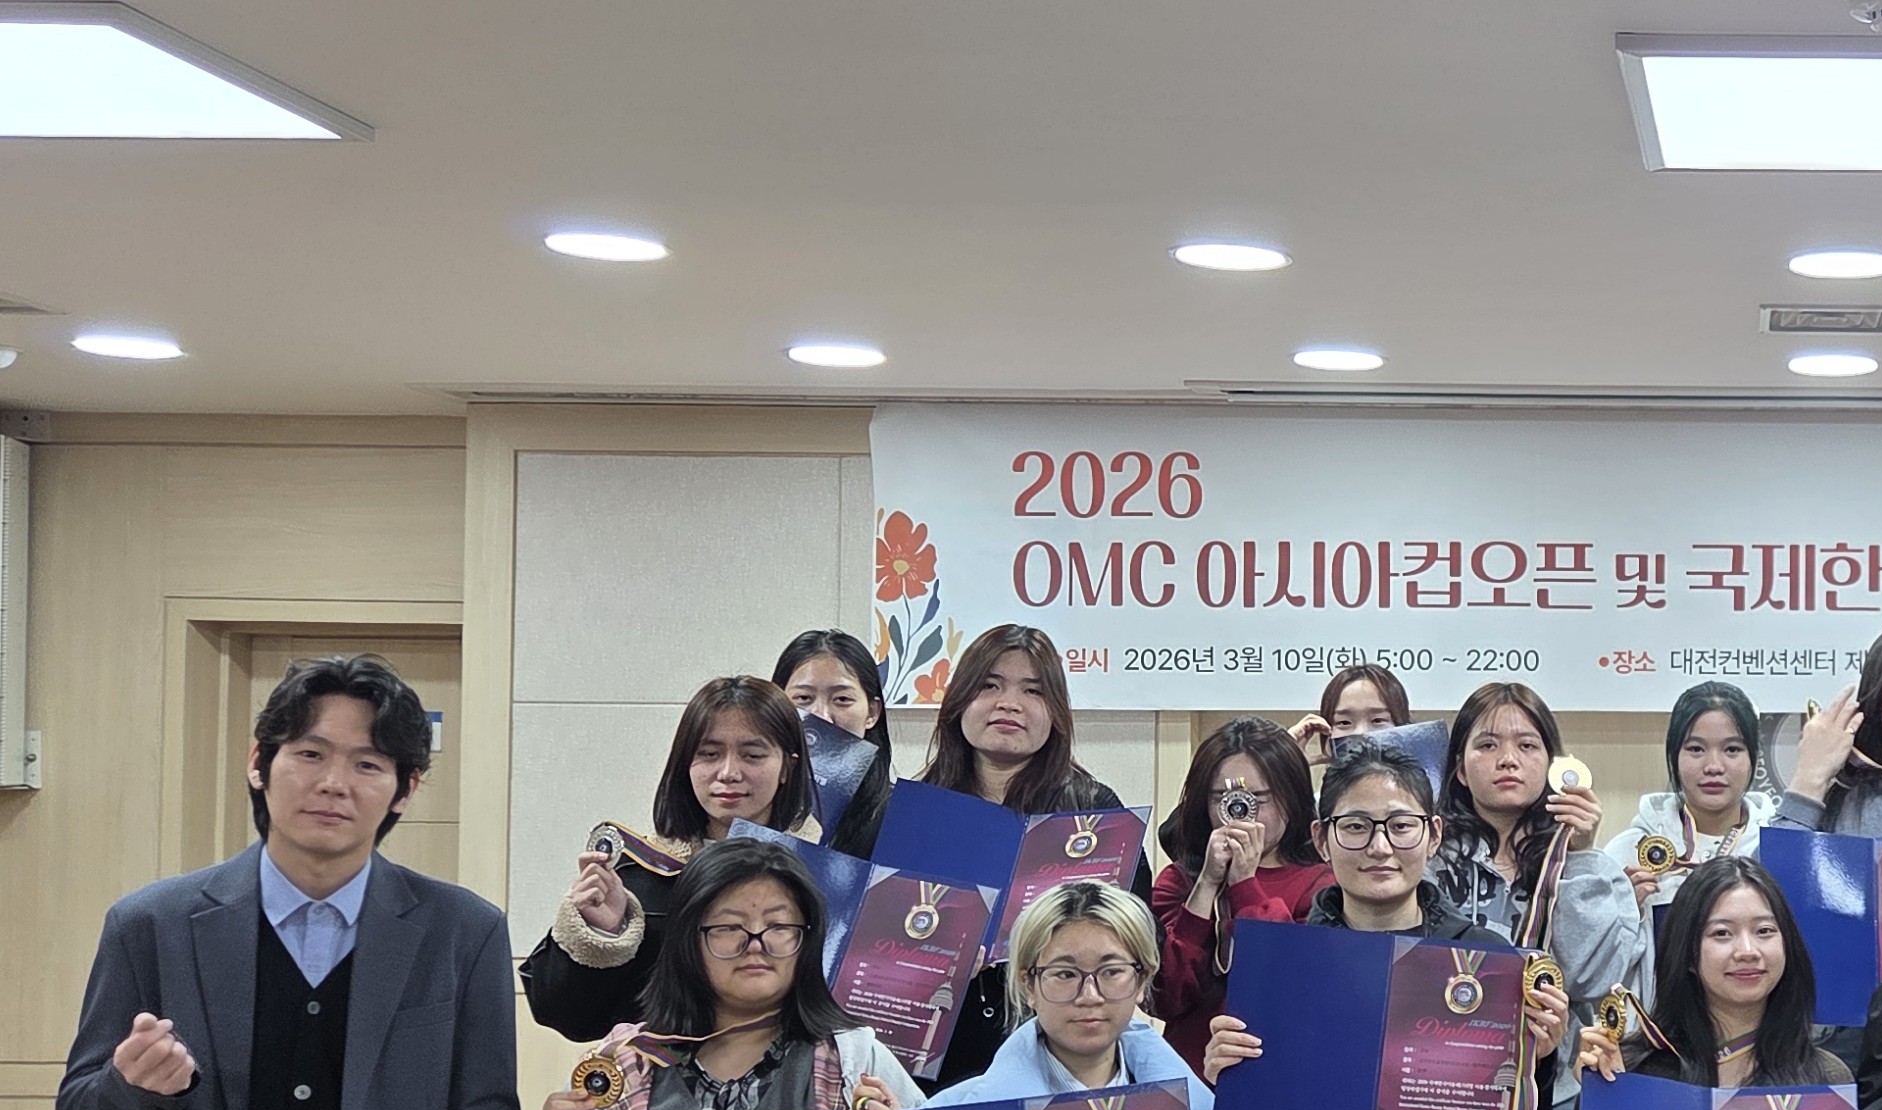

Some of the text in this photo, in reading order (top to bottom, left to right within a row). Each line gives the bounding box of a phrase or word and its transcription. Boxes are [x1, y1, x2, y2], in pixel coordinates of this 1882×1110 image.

[1011, 449, 1204, 519] 2026
[1012, 540, 1177, 609] OMC
[1195, 540, 1596, 612] 아시아컵오픈
[1614, 552, 1668, 610] 및
[1065, 647, 1110, 673] 일시
[1124, 646, 1215, 673] 2026년
[1223, 646, 1264, 673] 3월
[1271, 646, 1367, 677] 10일(화)
[1376, 648, 1433, 672] 5:00
[1466, 649, 1540, 672] 22:00
[1612, 649, 1657, 675] 장소
[1669, 647, 1837, 676] 대전컨벤션센터
